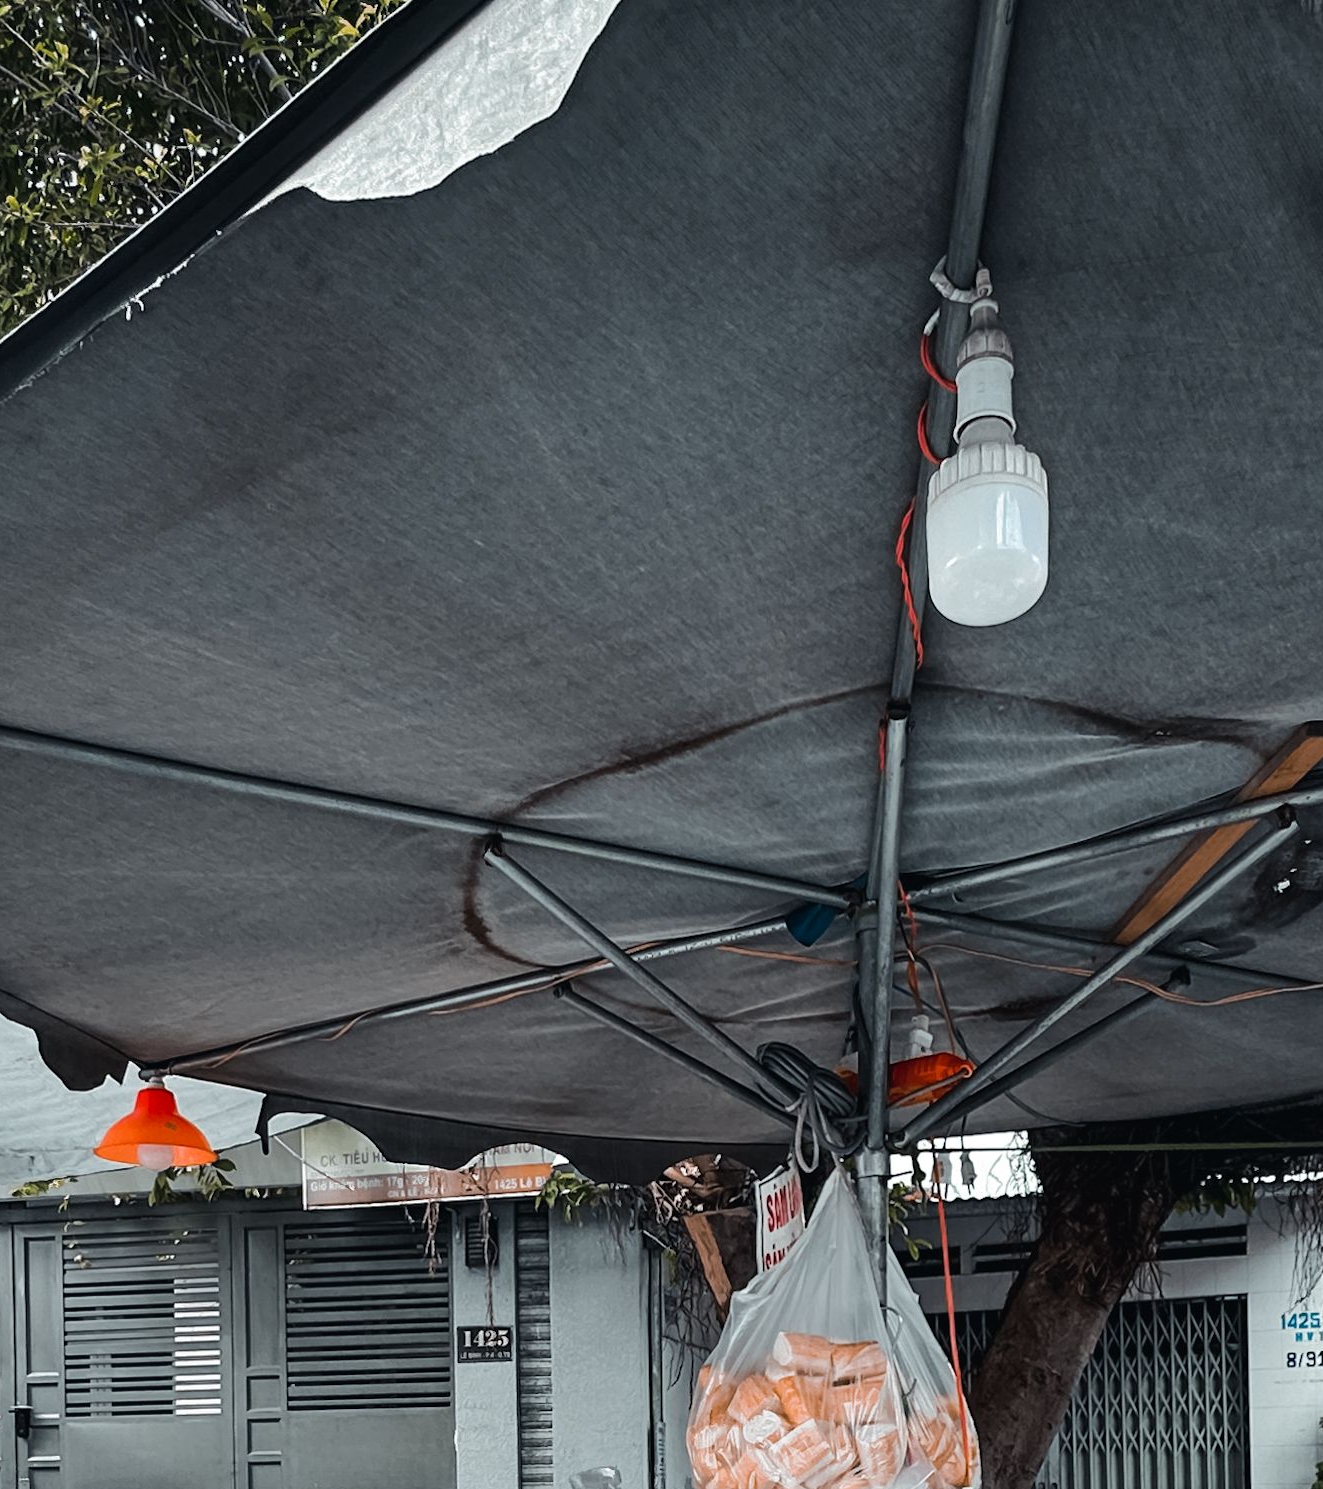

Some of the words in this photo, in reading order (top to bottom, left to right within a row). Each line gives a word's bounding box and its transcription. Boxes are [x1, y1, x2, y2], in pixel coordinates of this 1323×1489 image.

[495, 1178, 517, 1189] 1425
[1281, 1312, 1321, 1330] 1425
[464, 1330, 509, 1347] 1425
